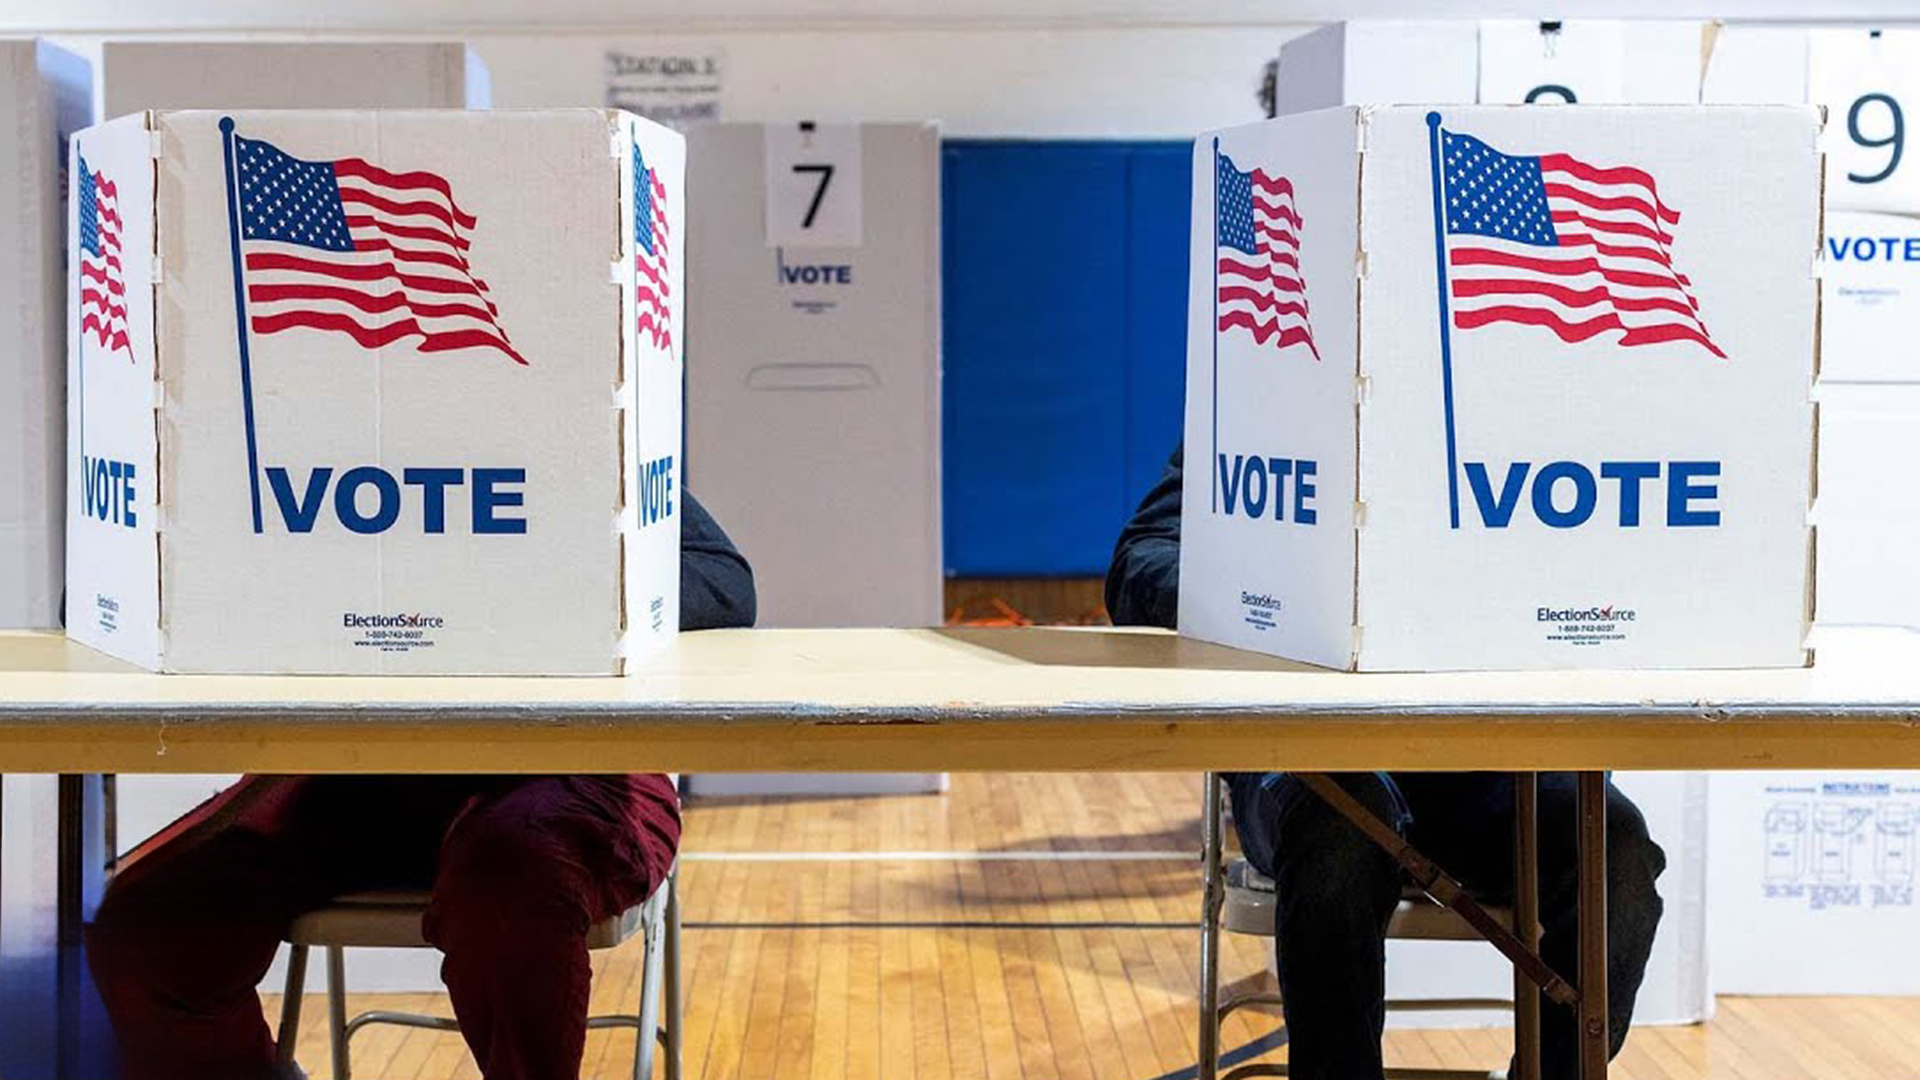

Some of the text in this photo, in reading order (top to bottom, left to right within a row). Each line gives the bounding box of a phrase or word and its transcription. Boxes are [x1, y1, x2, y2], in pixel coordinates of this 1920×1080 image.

[1847, 93, 1904, 184] 9
[792, 164, 835, 229] 7
[784, 265, 851, 285] VOTE
[1828, 237, 1920, 262] VOTE
[84, 455, 137, 528] VOTE
[264, 466, 527, 535] VOTE
[638, 455, 673, 528] VOTE
[1218, 453, 1317, 526] VOTE
[1462, 460, 1721, 529] VOTE
